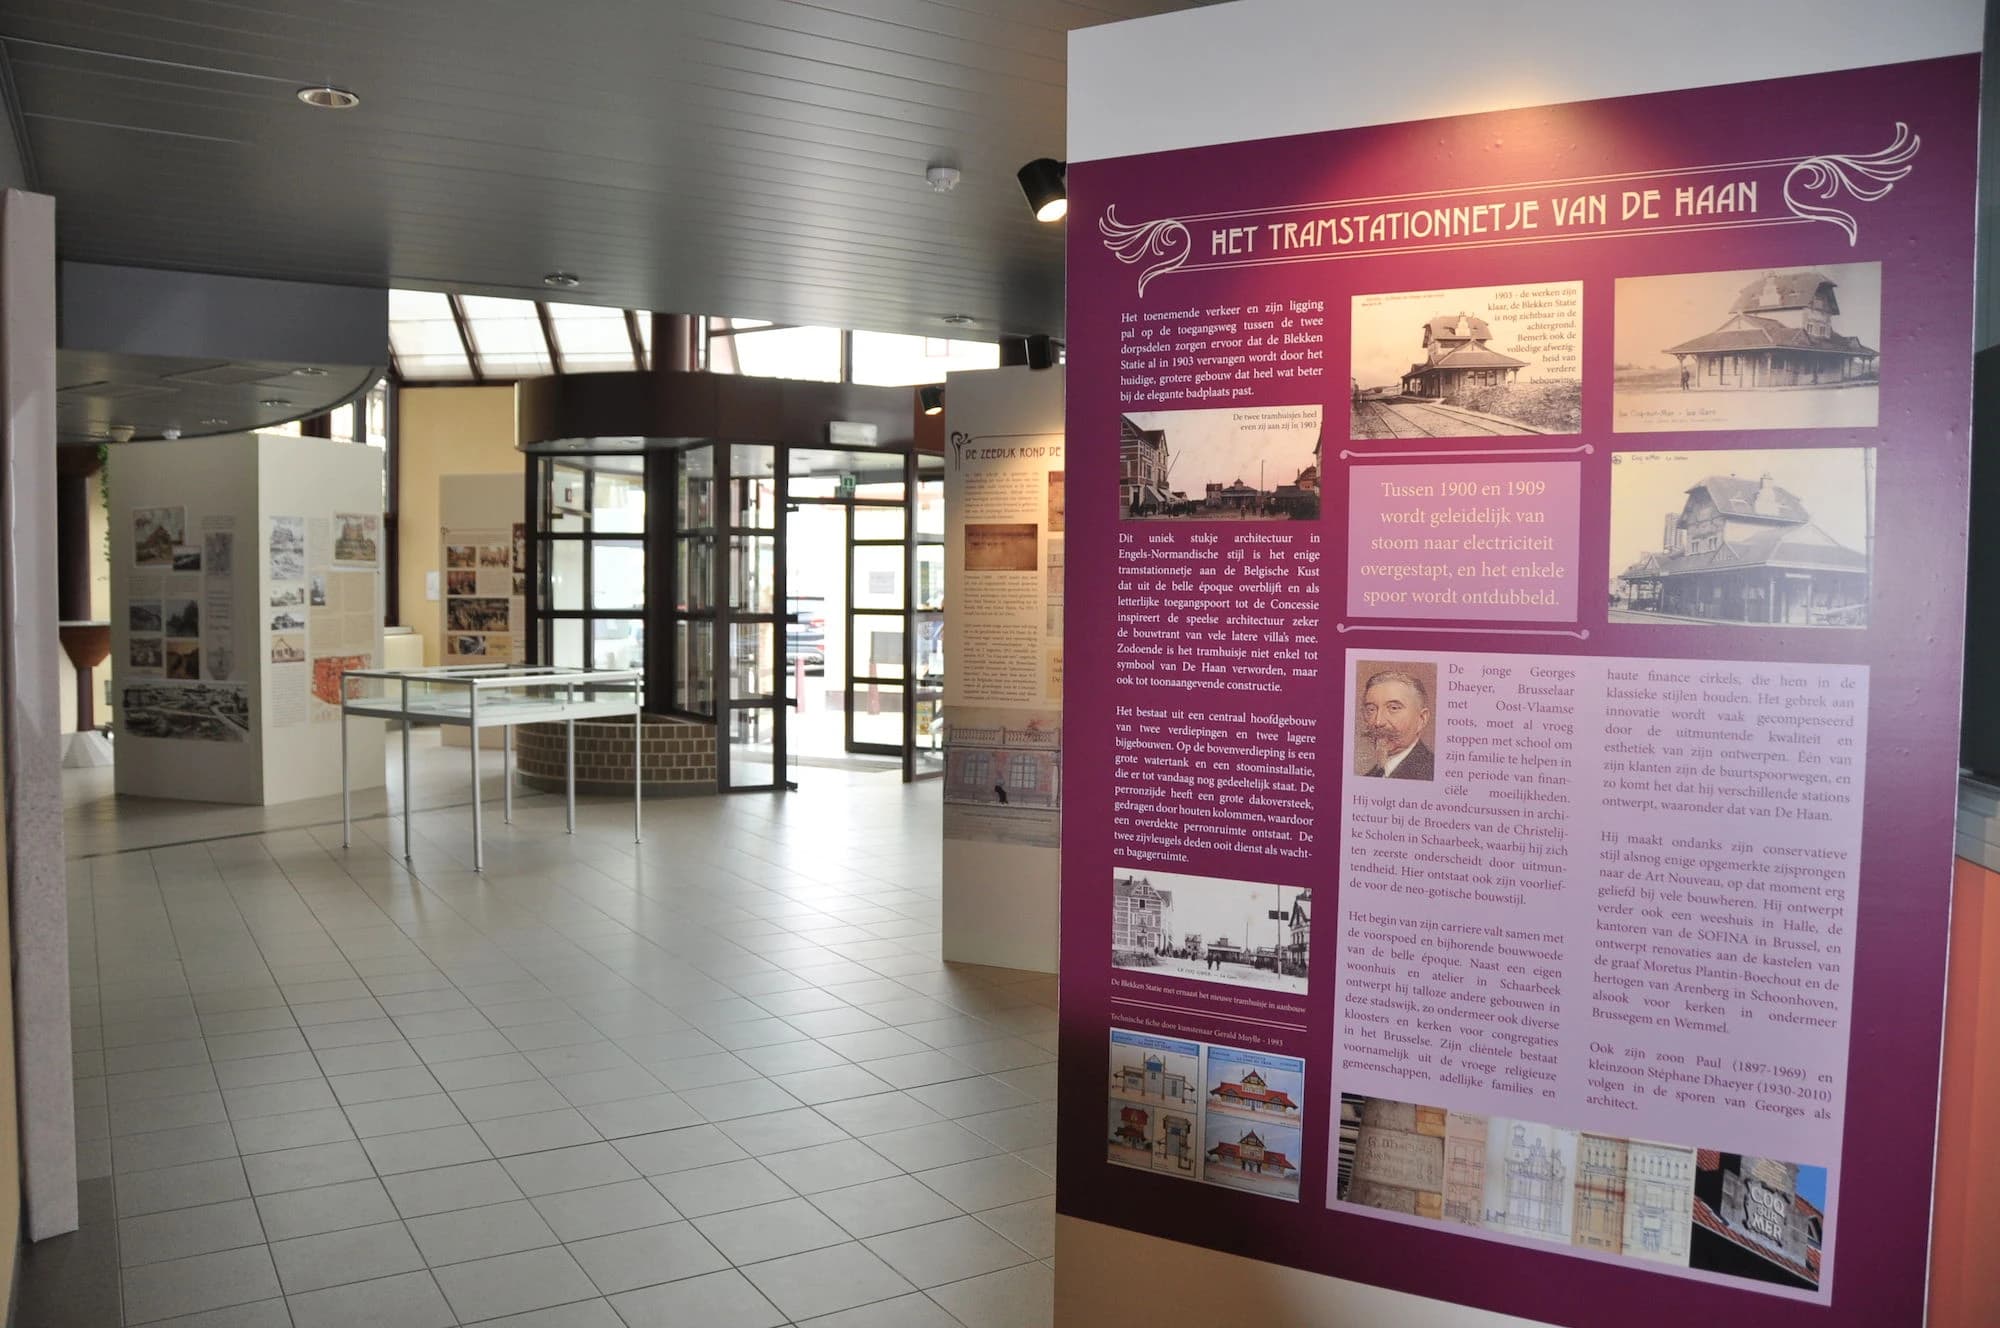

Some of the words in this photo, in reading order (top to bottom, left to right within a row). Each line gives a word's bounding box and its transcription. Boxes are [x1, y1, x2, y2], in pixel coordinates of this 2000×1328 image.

[1211, 226, 1258, 254] HET
[1267, 202, 1539, 247] TRAMSTATIONNETJE
[1551, 195, 1606, 225] VAN
[1621, 190, 1660, 219] DE
[1675, 183, 1756, 215] HAAN
[1121, 313, 1138, 322] Het
[1143, 308, 1200, 320] toenemende
[1205, 305, 1241, 315] verkeer
[1246, 305, 1259, 313] en
[1264, 302, 1283, 313] zijn
[1289, 300, 1324, 312] ligging
[1120, 327, 1134, 340] pal
[1140, 329, 1153, 339] op
[1159, 325, 1171, 335] de
[1177, 323, 1237, 335] toegangsweg
[1243, 321, 1274, 329] tussen
[1280, 317, 1293, 327] de
[1300, 317, 1323, 326] twee
[1120, 342, 1170, 355] dorpsdelen
[1175, 341, 1206, 352] zorgen
[1210, 339, 1242, 348] ervoor
[1246, 335, 1262, 346] dat
[1266, 334, 1279, 344] de
[1283, 332, 1322, 343] Blekken
[1120, 359, 1145, 369] Statie
[1147, 357, 1156, 368] al
[1159, 358, 1168, 367] in
[1172, 356, 1194, 366] 1903
[1196, 355, 1245, 366] vervangen
[1248, 351, 1276, 361] wordt
[1279, 350, 1304, 360] door
[1306, 348, 1323, 358] het
[1120, 375, 1156, 386] huidige,
[1159, 374, 1192, 385] grotere
[1194, 371, 1231, 384] gebouw
[1234, 369, 1250, 379] dat
[1253, 367, 1273, 378] heel
[1276, 368, 1293, 376] wat
[1297, 366, 1323, 376] beter
[1545, 364, 1576, 372] verdere
[1119, 391, 1131, 403] bij
[1133, 390, 1145, 400] de
[1146, 390, 1184, 401] elegante
[1185, 387, 1230, 399] badplaats
[1231, 387, 1254, 398] past.
[1261, 411, 1301, 420] tramhuisjes
[1302, 410, 1317, 418] heel
[965, 449, 977, 460] DE
[980, 447, 1016, 459] ZEEDIJK
[1020, 447, 1045, 459] ROND
[1049, 446, 1061, 457] DE
[1380, 482, 1433, 496] Tussen
[1440, 482, 1477, 495] 1900
[1481, 485, 1500, 495] en
[1504, 480, 1545, 495] 1909
[1381, 508, 1424, 522] wordt
[1430, 507, 1510, 527] geleidelijk
[1516, 512, 1543, 522] van
[1119, 533, 1132, 542] Dit
[1148, 532, 1174, 542] uniek
[1190, 532, 1217, 544] stukje
[1234, 533, 1291, 542] architectuur
[1310, 533, 1320, 542] in
[1371, 537, 1418, 549] stoom
[1423, 539, 1459, 549] naar
[1463, 535, 1552, 549] electriciteit
[1118, 548, 1218, 560] Engels-Normandische
[1226, 549, 1244, 561] stijl
[1252, 549, 1261, 559] is
[1269, 549, 1284, 559] het
[1293, 550, 1320, 562] enige
[1118, 566, 1191, 575] tramstationnetje
[1199, 567, 1216, 575] aan
[1223, 565, 1235, 575] de
[1244, 565, 1288, 578] Belgische
[1297, 566, 1319, 576] Kust
[1360, 564, 1452, 580] overgestapt,
[1457, 566, 1475, 576] en
[1481, 561, 1507, 576] het
[1511, 562, 1564, 577] enkele
[1363, 591, 1407, 605] spoor
[1411, 588, 1456, 602] wordt
[1462, 589, 1559, 604] ontdubbeld.
[1448, 663, 1464, 673] De
[1482, 665, 1511, 678] jonge
[1529, 666, 1576, 680] Georges
[1448, 681, 1495, 694] Dhaeyer,
[1517, 684, 1575, 695] Brusselaar
[1447, 700, 1468, 709] met
[1495, 700, 1574, 713] Oost-Vlaamse
[1116, 705, 1132, 715] Het
[1136, 707, 1167, 717] bestaat
[1171, 709, 1183, 718] uit
[1187, 712, 1204, 720] een
[1208, 712, 1245, 722] centraal
[1250, 713, 1316, 727] hoofdgebouw
[1589, 1042, 1614, 1054] Ook
[1624, 1047, 1645, 1059] zijn
[1655, 1053, 1684, 1063] zoon
[1696, 1055, 1721, 1067] Paul
[1732, 1061, 1806, 1079] (1897-1969)
[1817, 1074, 1832, 1083] en
[1588, 1059, 1644, 1075] kleinzoon
[1646, 1067, 1700, 1083] Stéphane
[1703, 1074, 1754, 1090] Dhaeyer
[1756, 1082, 1831, 1101] (1930-2010)
[1585, 1095, 1638, 1109] architect.
[1751, 1187, 1784, 1217] COQ
[1753, 1213, 1781, 1239] MER
